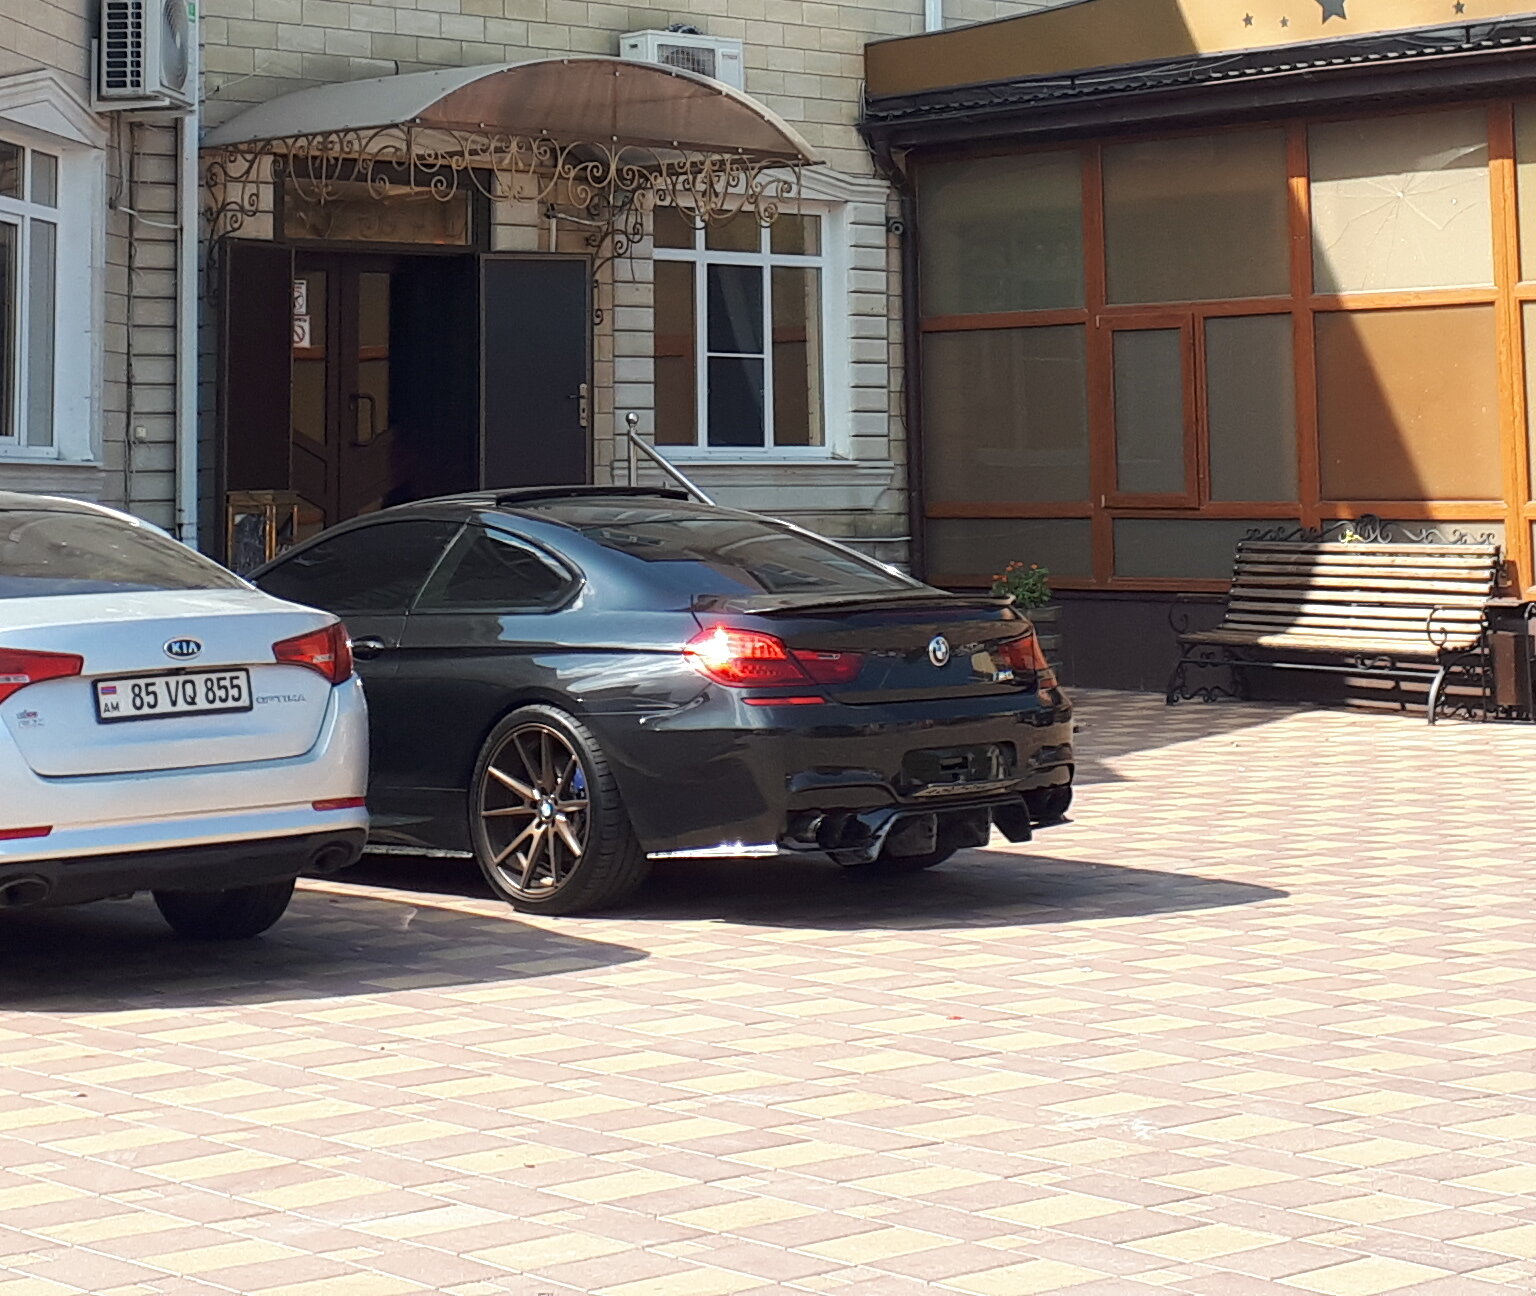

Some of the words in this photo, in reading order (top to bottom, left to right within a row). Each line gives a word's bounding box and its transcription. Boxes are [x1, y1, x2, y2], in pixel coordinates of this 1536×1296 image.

[171, 641, 198, 654] KIA
[131, 681, 159, 712] 85
[164, 679, 198, 708] VQ
[204, 675, 243, 705] 855
[103, 702, 120, 714] AM
